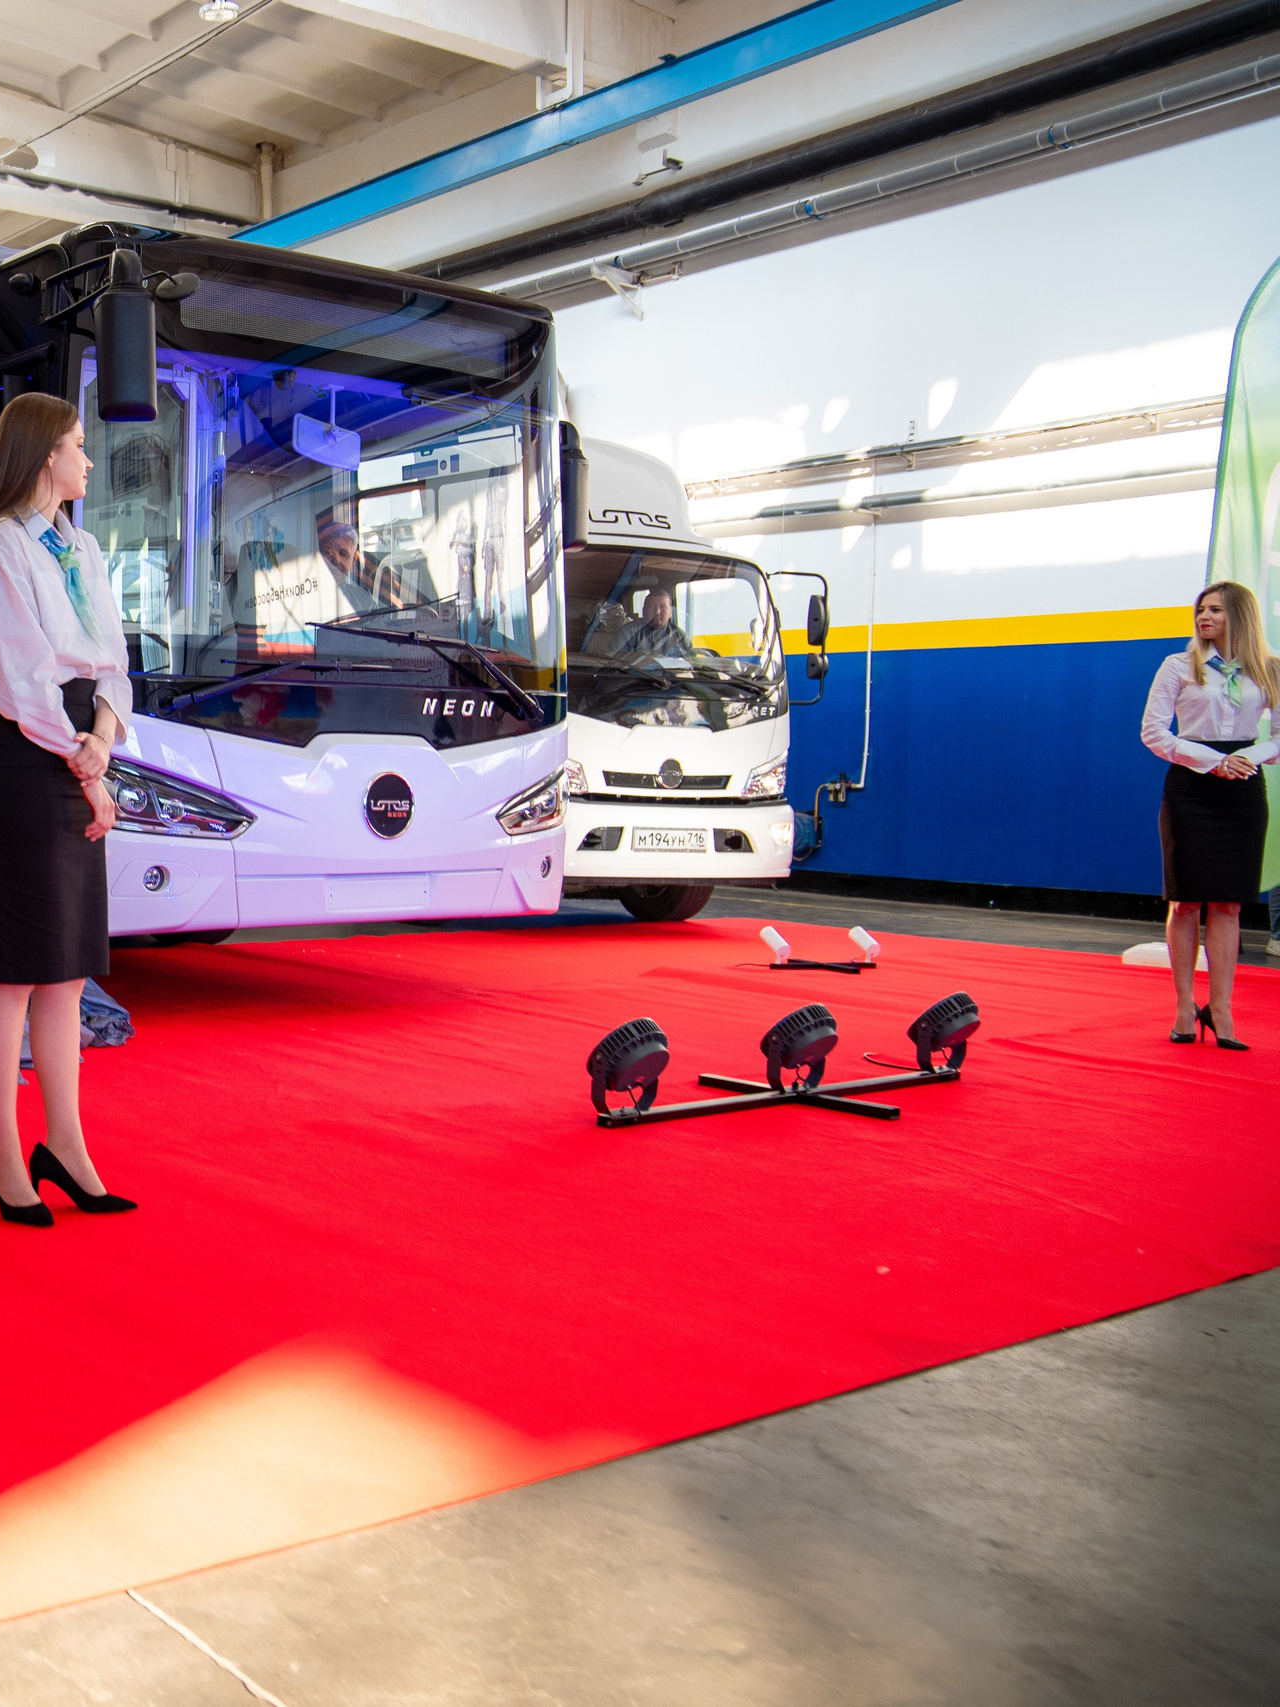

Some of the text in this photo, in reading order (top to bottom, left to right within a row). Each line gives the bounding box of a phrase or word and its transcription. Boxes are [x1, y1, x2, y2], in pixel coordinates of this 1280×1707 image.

[422, 697, 495, 717] NEON
[370, 799, 410, 811] LOTOS
[687, 832, 705, 844] 716
